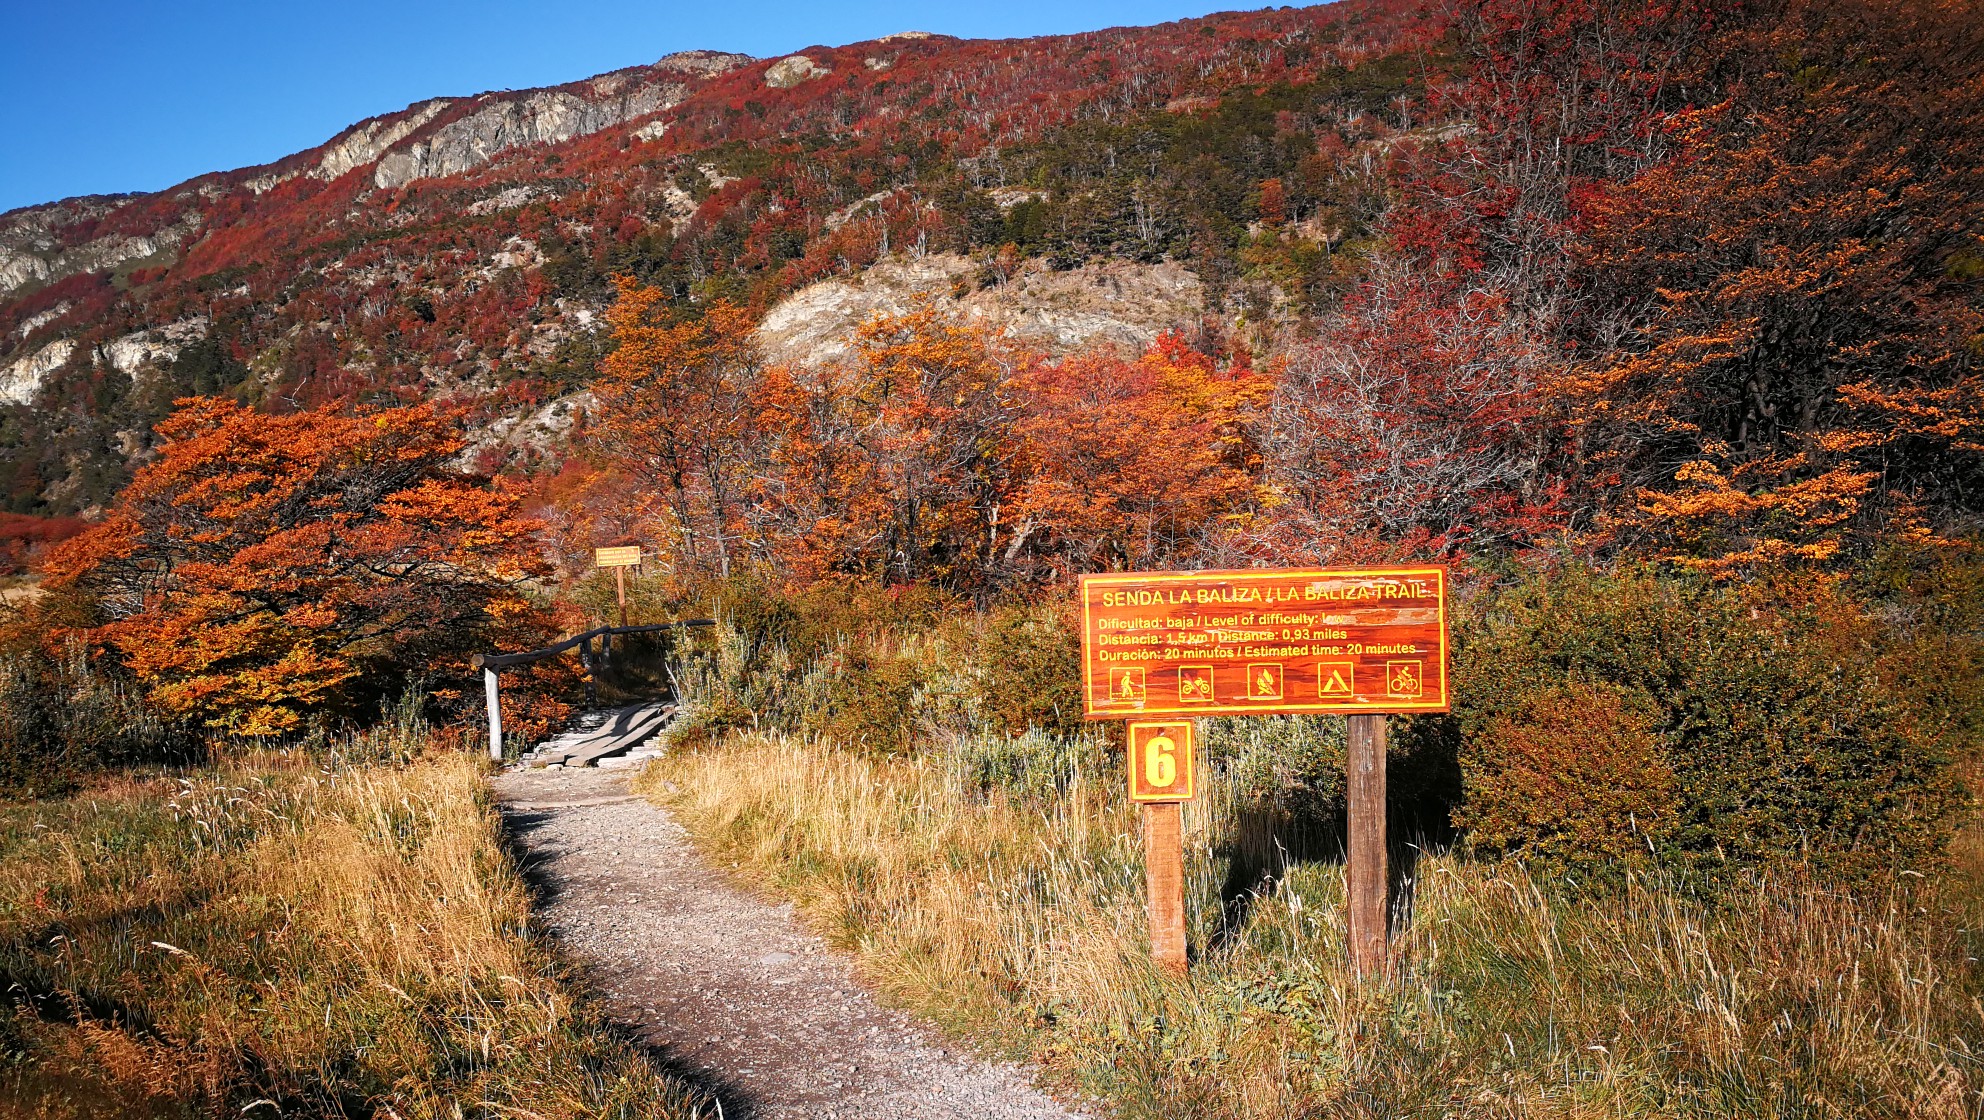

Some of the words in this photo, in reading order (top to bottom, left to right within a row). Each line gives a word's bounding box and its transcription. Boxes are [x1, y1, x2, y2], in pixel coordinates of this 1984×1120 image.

[1102, 590, 1164, 607] SENDA
[1169, 589, 1192, 605] LA
[1197, 587, 1262, 604] BALIZA
[1277, 586, 1300, 602] LA
[1305, 585, 1370, 601] BALIZA
[1376, 584, 1427, 599] TRAIL
[1098, 617, 1163, 630] Dificultad:
[1166, 616, 1194, 630] baja
[1197, 616, 1201, 627] /
[1204, 615, 1238, 627] Level
[1241, 614, 1255, 626] of
[1258, 613, 1319, 626] difficulty:
[1099, 633, 1162, 646] Distancia:
[1166, 632, 1186, 646] 1,5
[1189, 631, 1208, 644] km
[1211, 631, 1216, 643] /
[1219, 630, 1279, 642] Distance:
[1282, 629, 1310, 642] 0,93
[1313, 628, 1347, 640] miles
[1099, 648, 1161, 661] Duración:
[1164, 648, 1180, 660] 20
[1183, 647, 1234, 659] minutos
[1237, 646, 1241, 657] /
[1244, 645, 1309, 657] Estimated
[1311, 644, 1343, 656] time:
[1346, 643, 1362, 655] 20
[1365, 643, 1416, 654] minutes
[1145, 736, 1176, 788] 6
